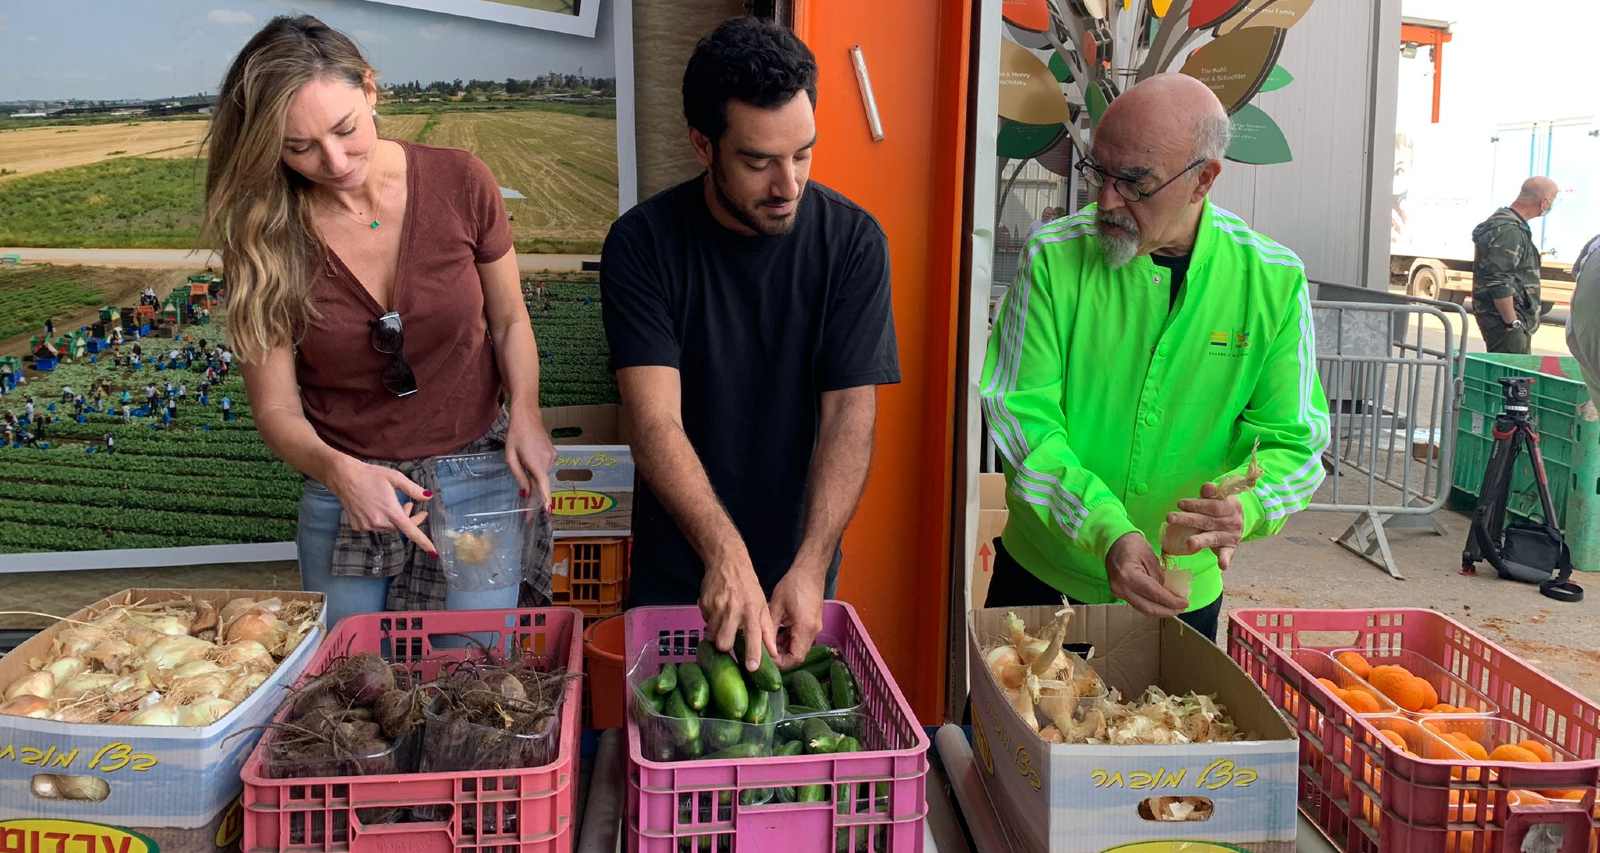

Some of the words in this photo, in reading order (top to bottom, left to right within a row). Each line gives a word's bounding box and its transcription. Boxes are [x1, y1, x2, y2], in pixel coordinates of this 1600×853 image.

[0, 744, 80, 769] מובח
[88, 742, 159, 773] בצל
[1090, 766, 1188, 791] מובחר
[1196, 757, 1259, 791] בצל
